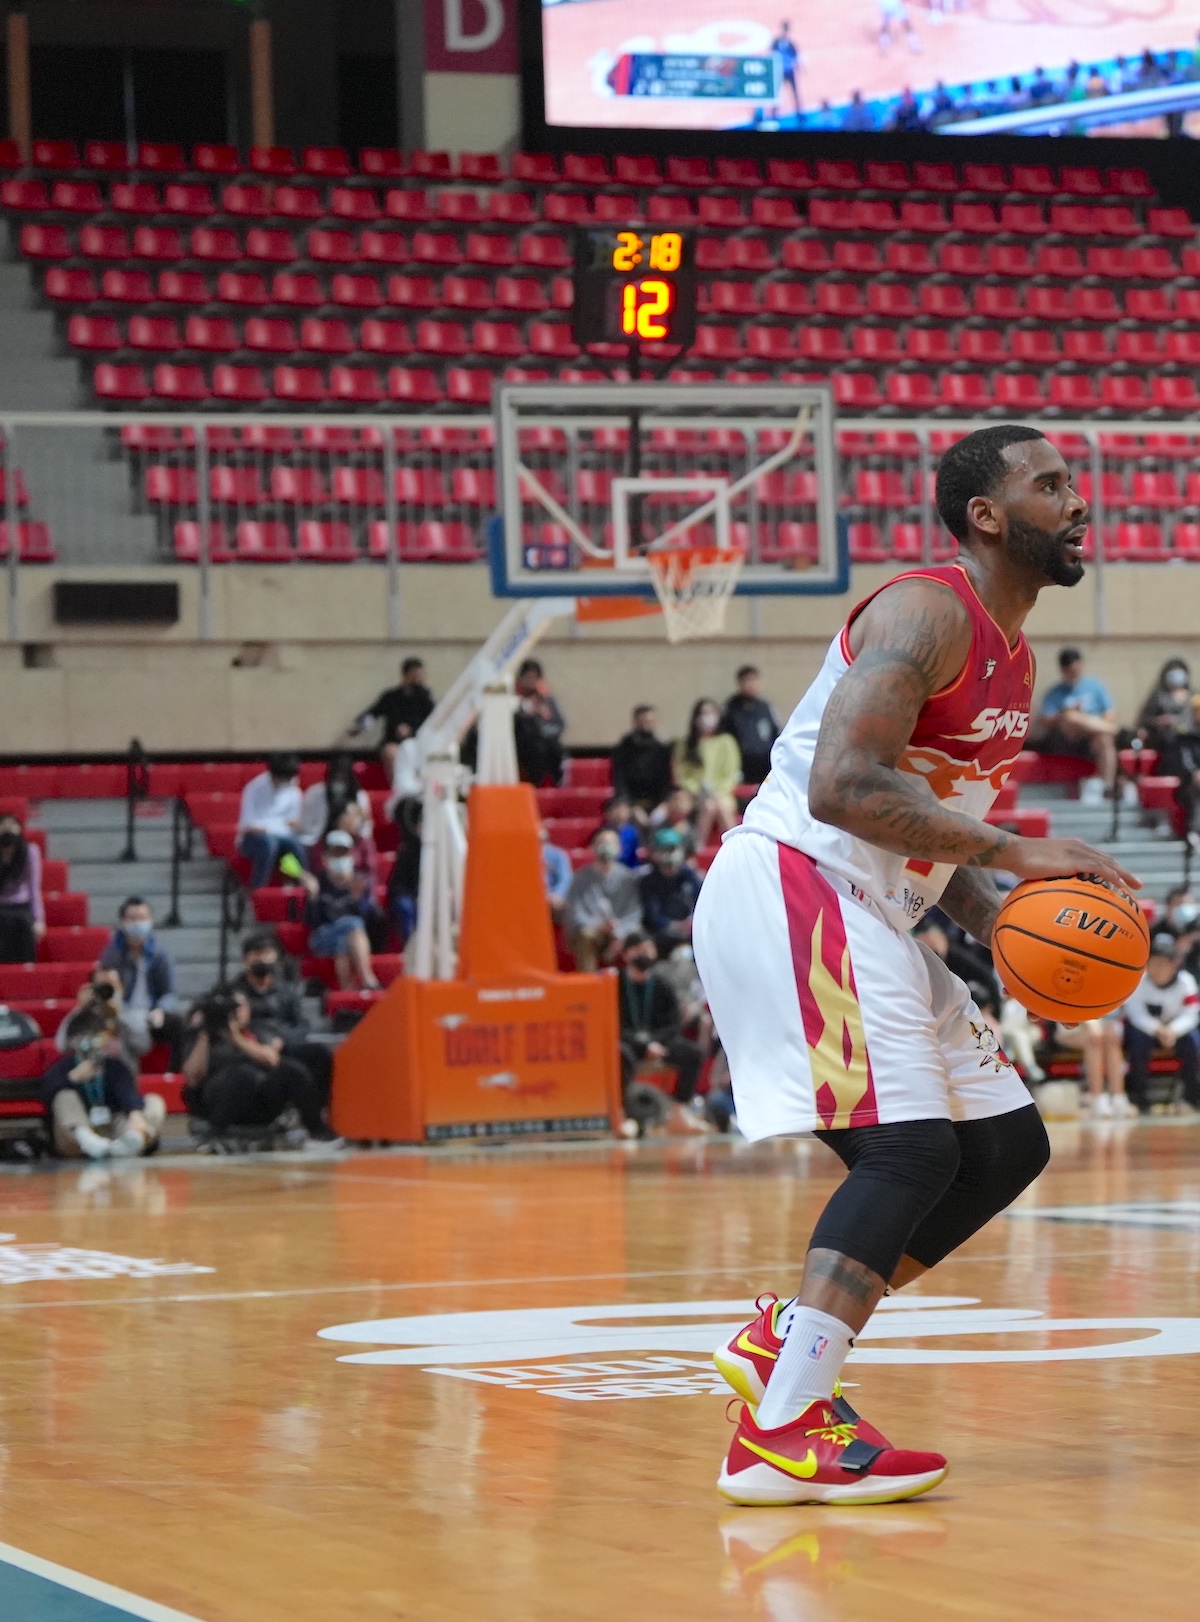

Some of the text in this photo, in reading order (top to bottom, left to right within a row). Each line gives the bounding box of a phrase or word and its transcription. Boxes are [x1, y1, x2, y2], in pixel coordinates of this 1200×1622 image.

[443, 0, 505, 52] D
[613, 231, 683, 271] 2:18
[622, 280, 670, 338] 12
[1054, 907, 1120, 940] EVO
